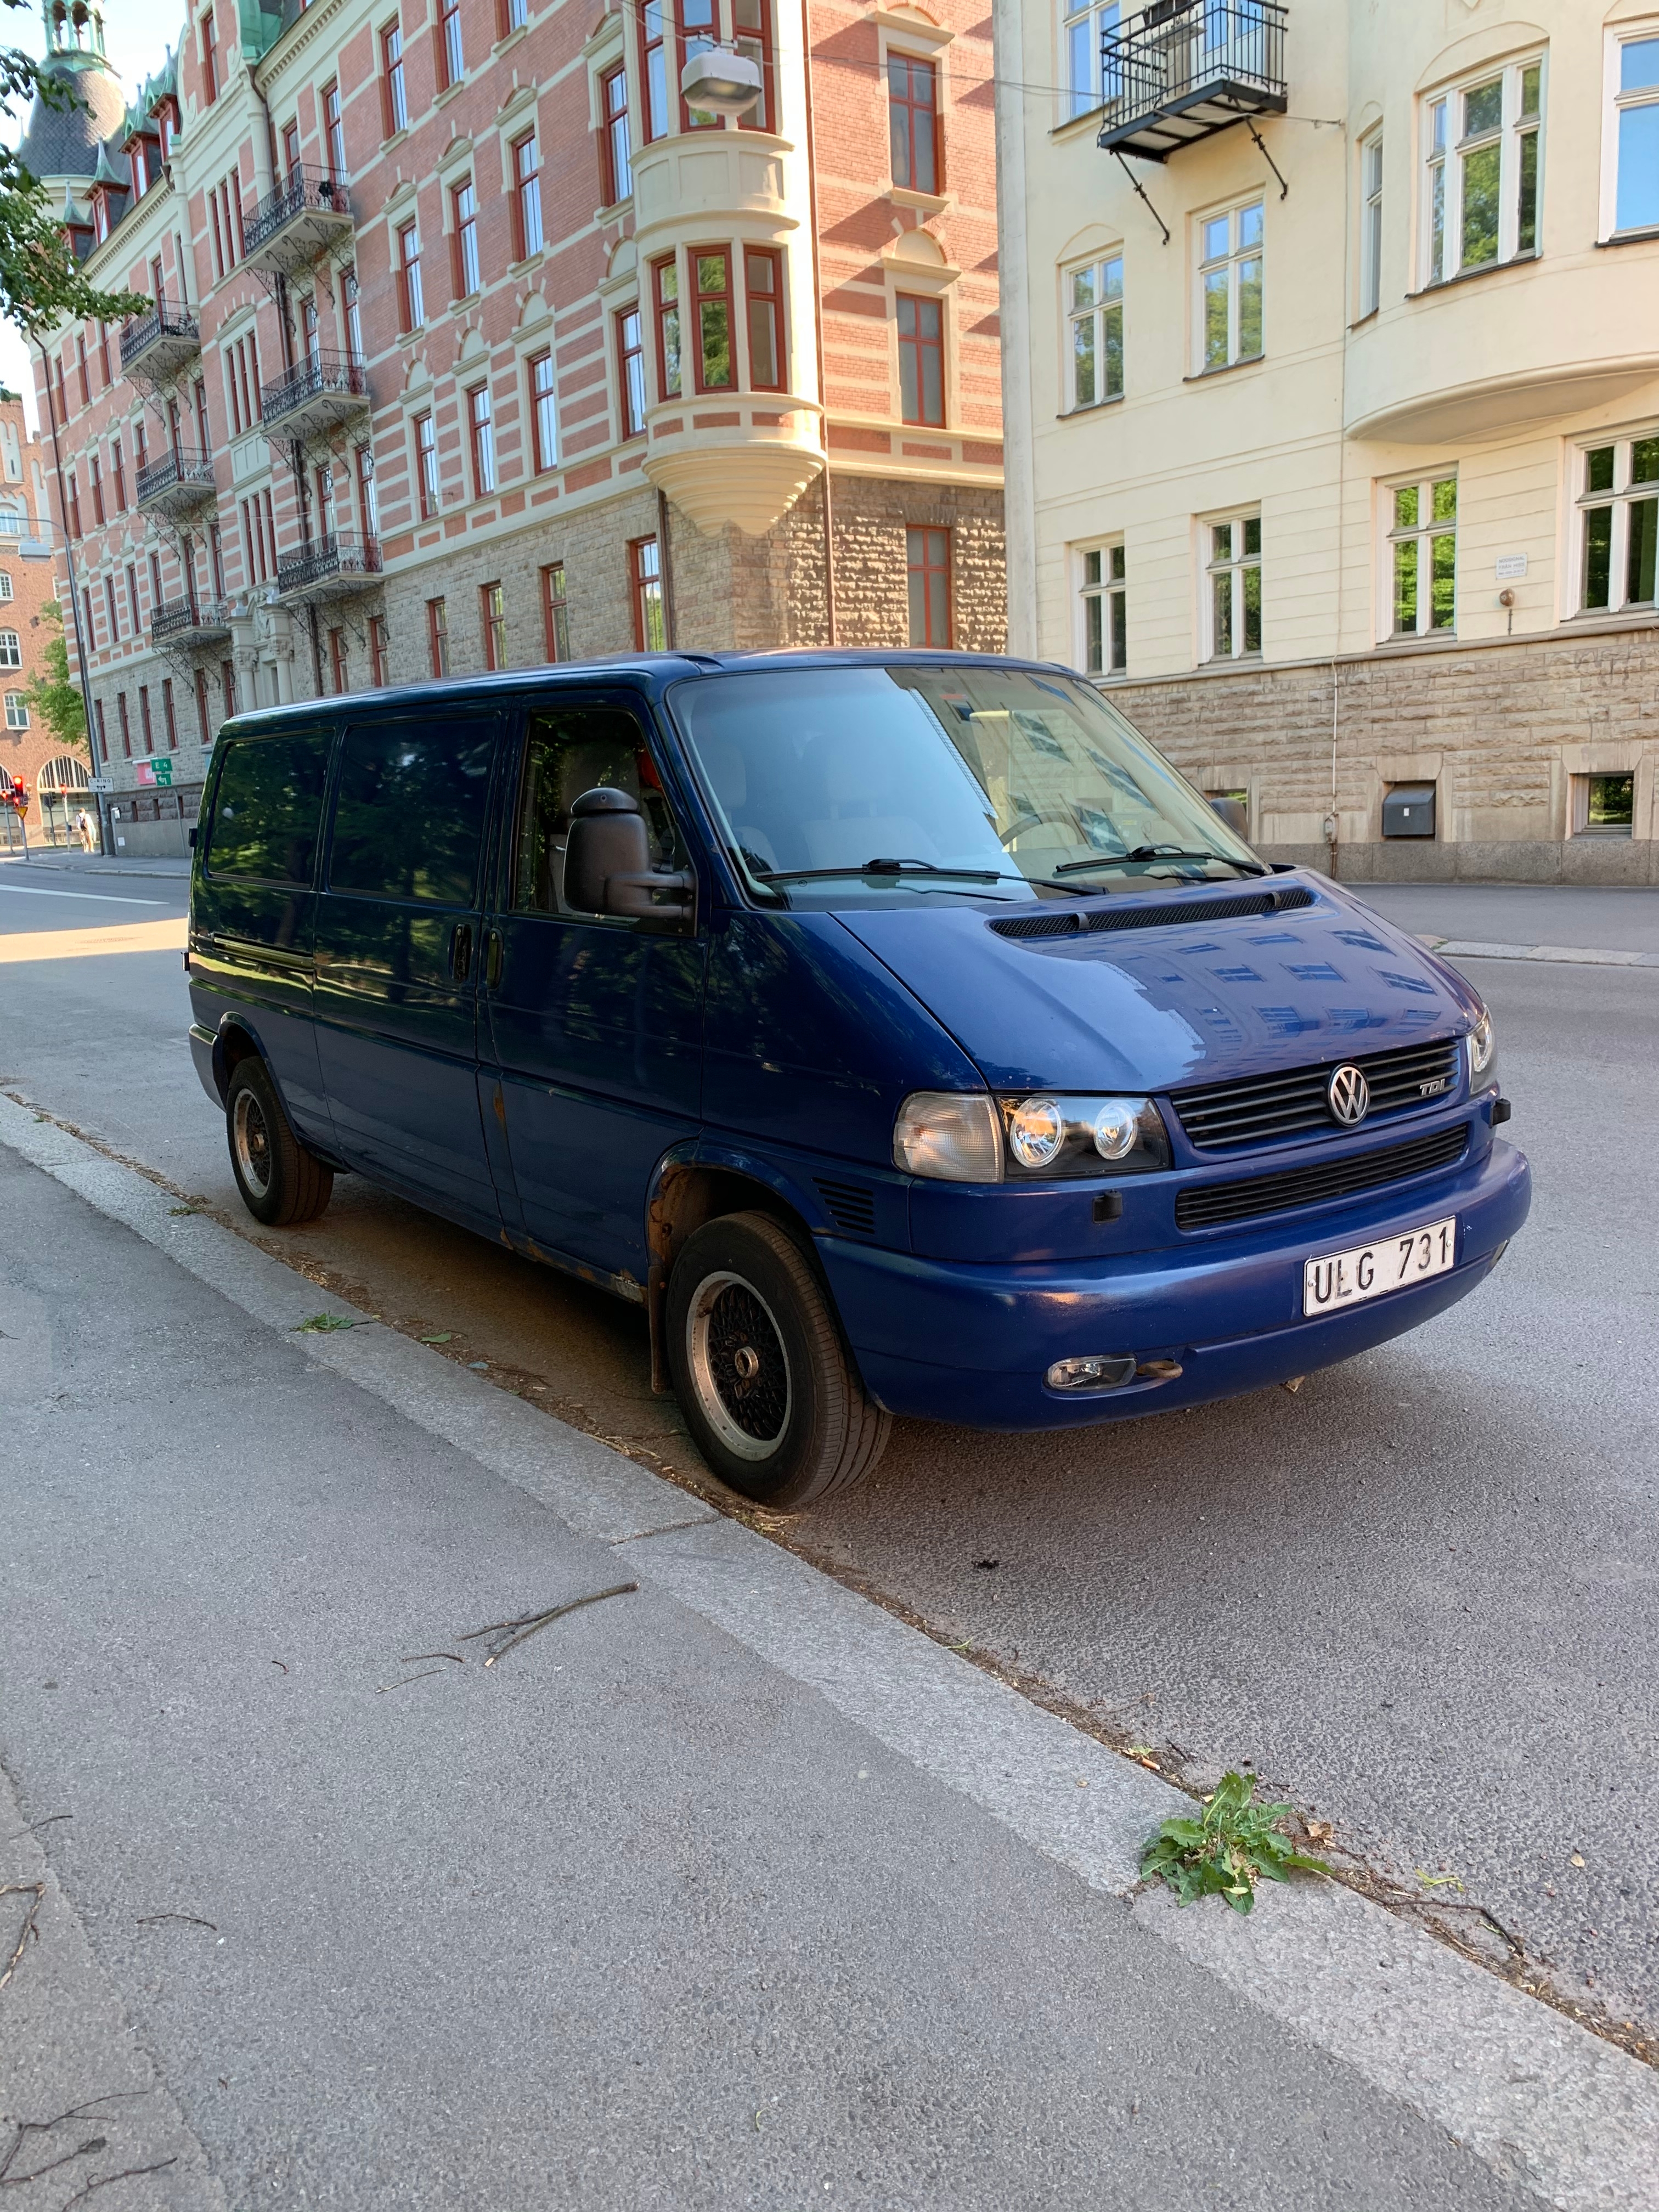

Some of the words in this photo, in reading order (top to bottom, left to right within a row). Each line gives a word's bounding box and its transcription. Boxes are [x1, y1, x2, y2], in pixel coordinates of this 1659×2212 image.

[1420, 1079, 1446, 1096] TDI
[1316, 1251, 1374, 1303] ULG
[1398, 1226, 1447, 1279] 731
